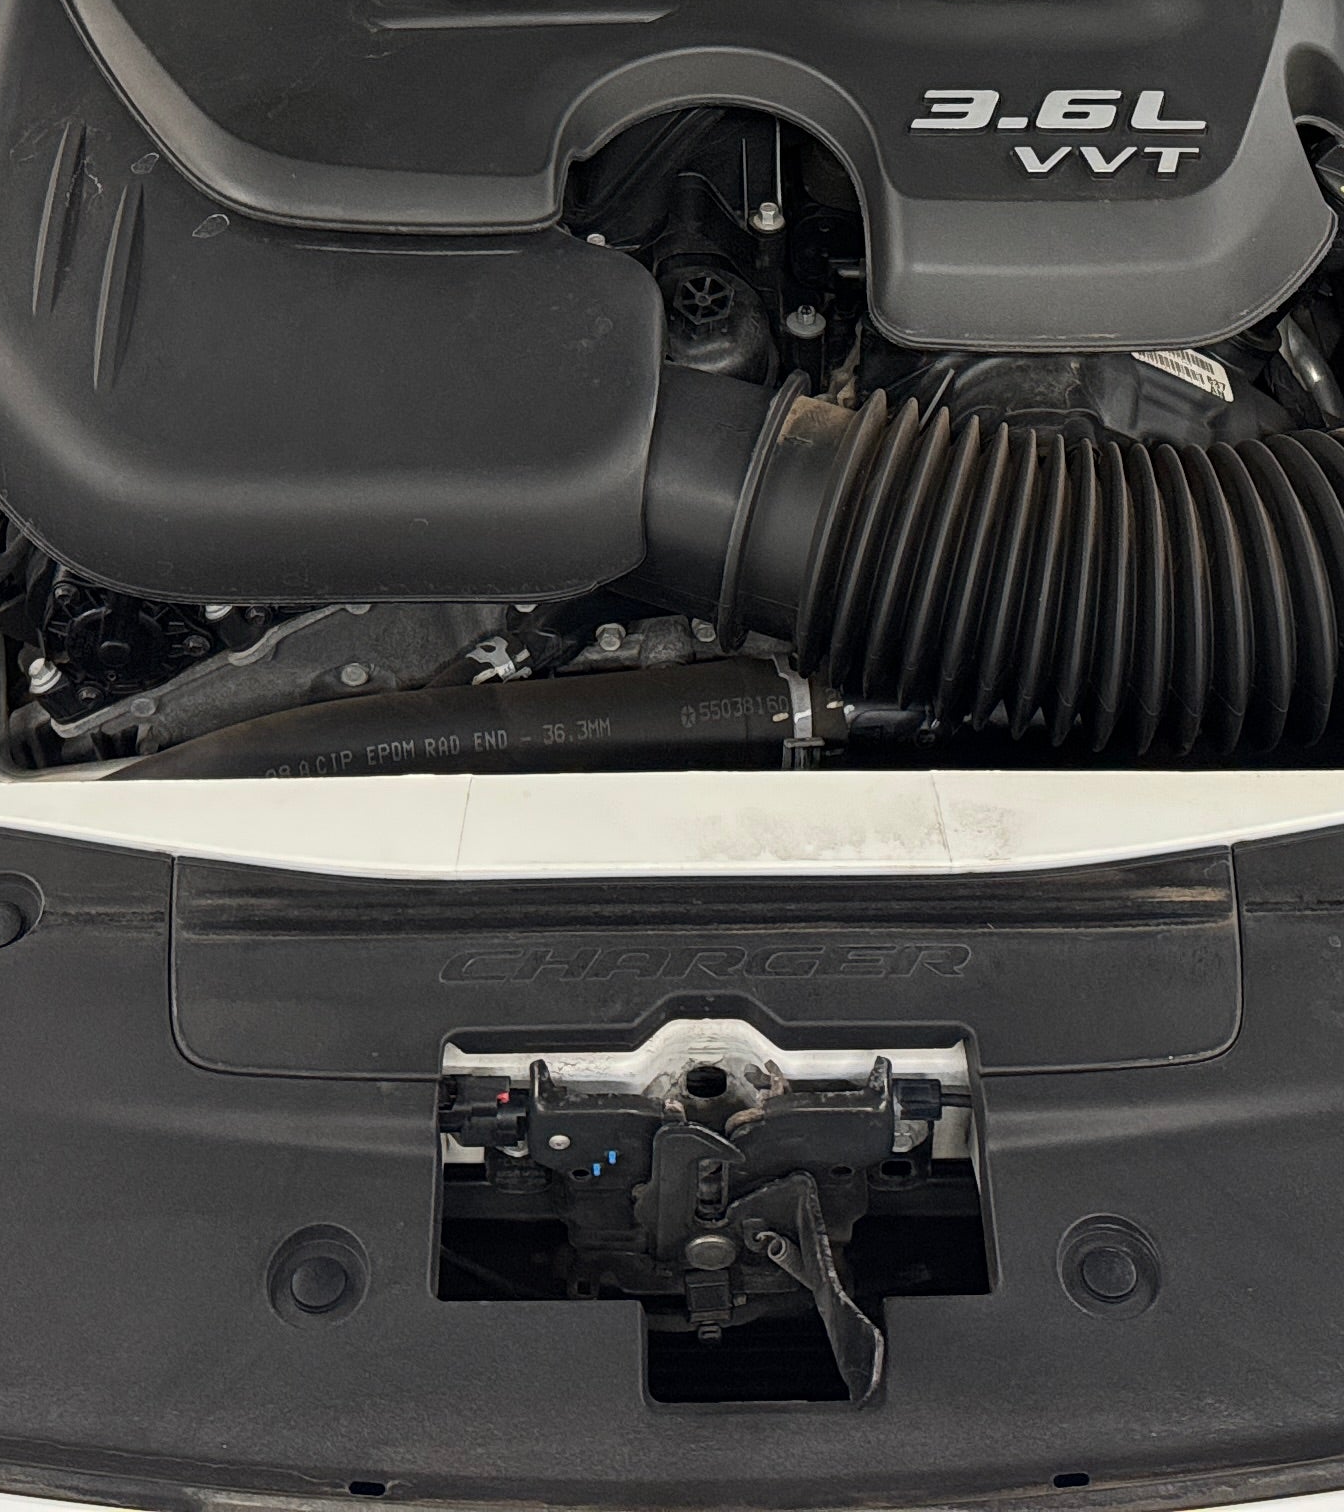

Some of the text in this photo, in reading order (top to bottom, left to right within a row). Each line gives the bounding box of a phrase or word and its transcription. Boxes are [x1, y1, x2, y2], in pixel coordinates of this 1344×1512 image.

[909, 89, 1208, 131] 3.6L
[1013, 145, 1201, 174] VVT
[366, 739, 416, 766] EPDM
[424, 735, 460, 758] RAD
[473, 729, 508, 753] END
[542, 717, 612, 745] 36.3MM
[439, 942, 973, 985] CHARGER
